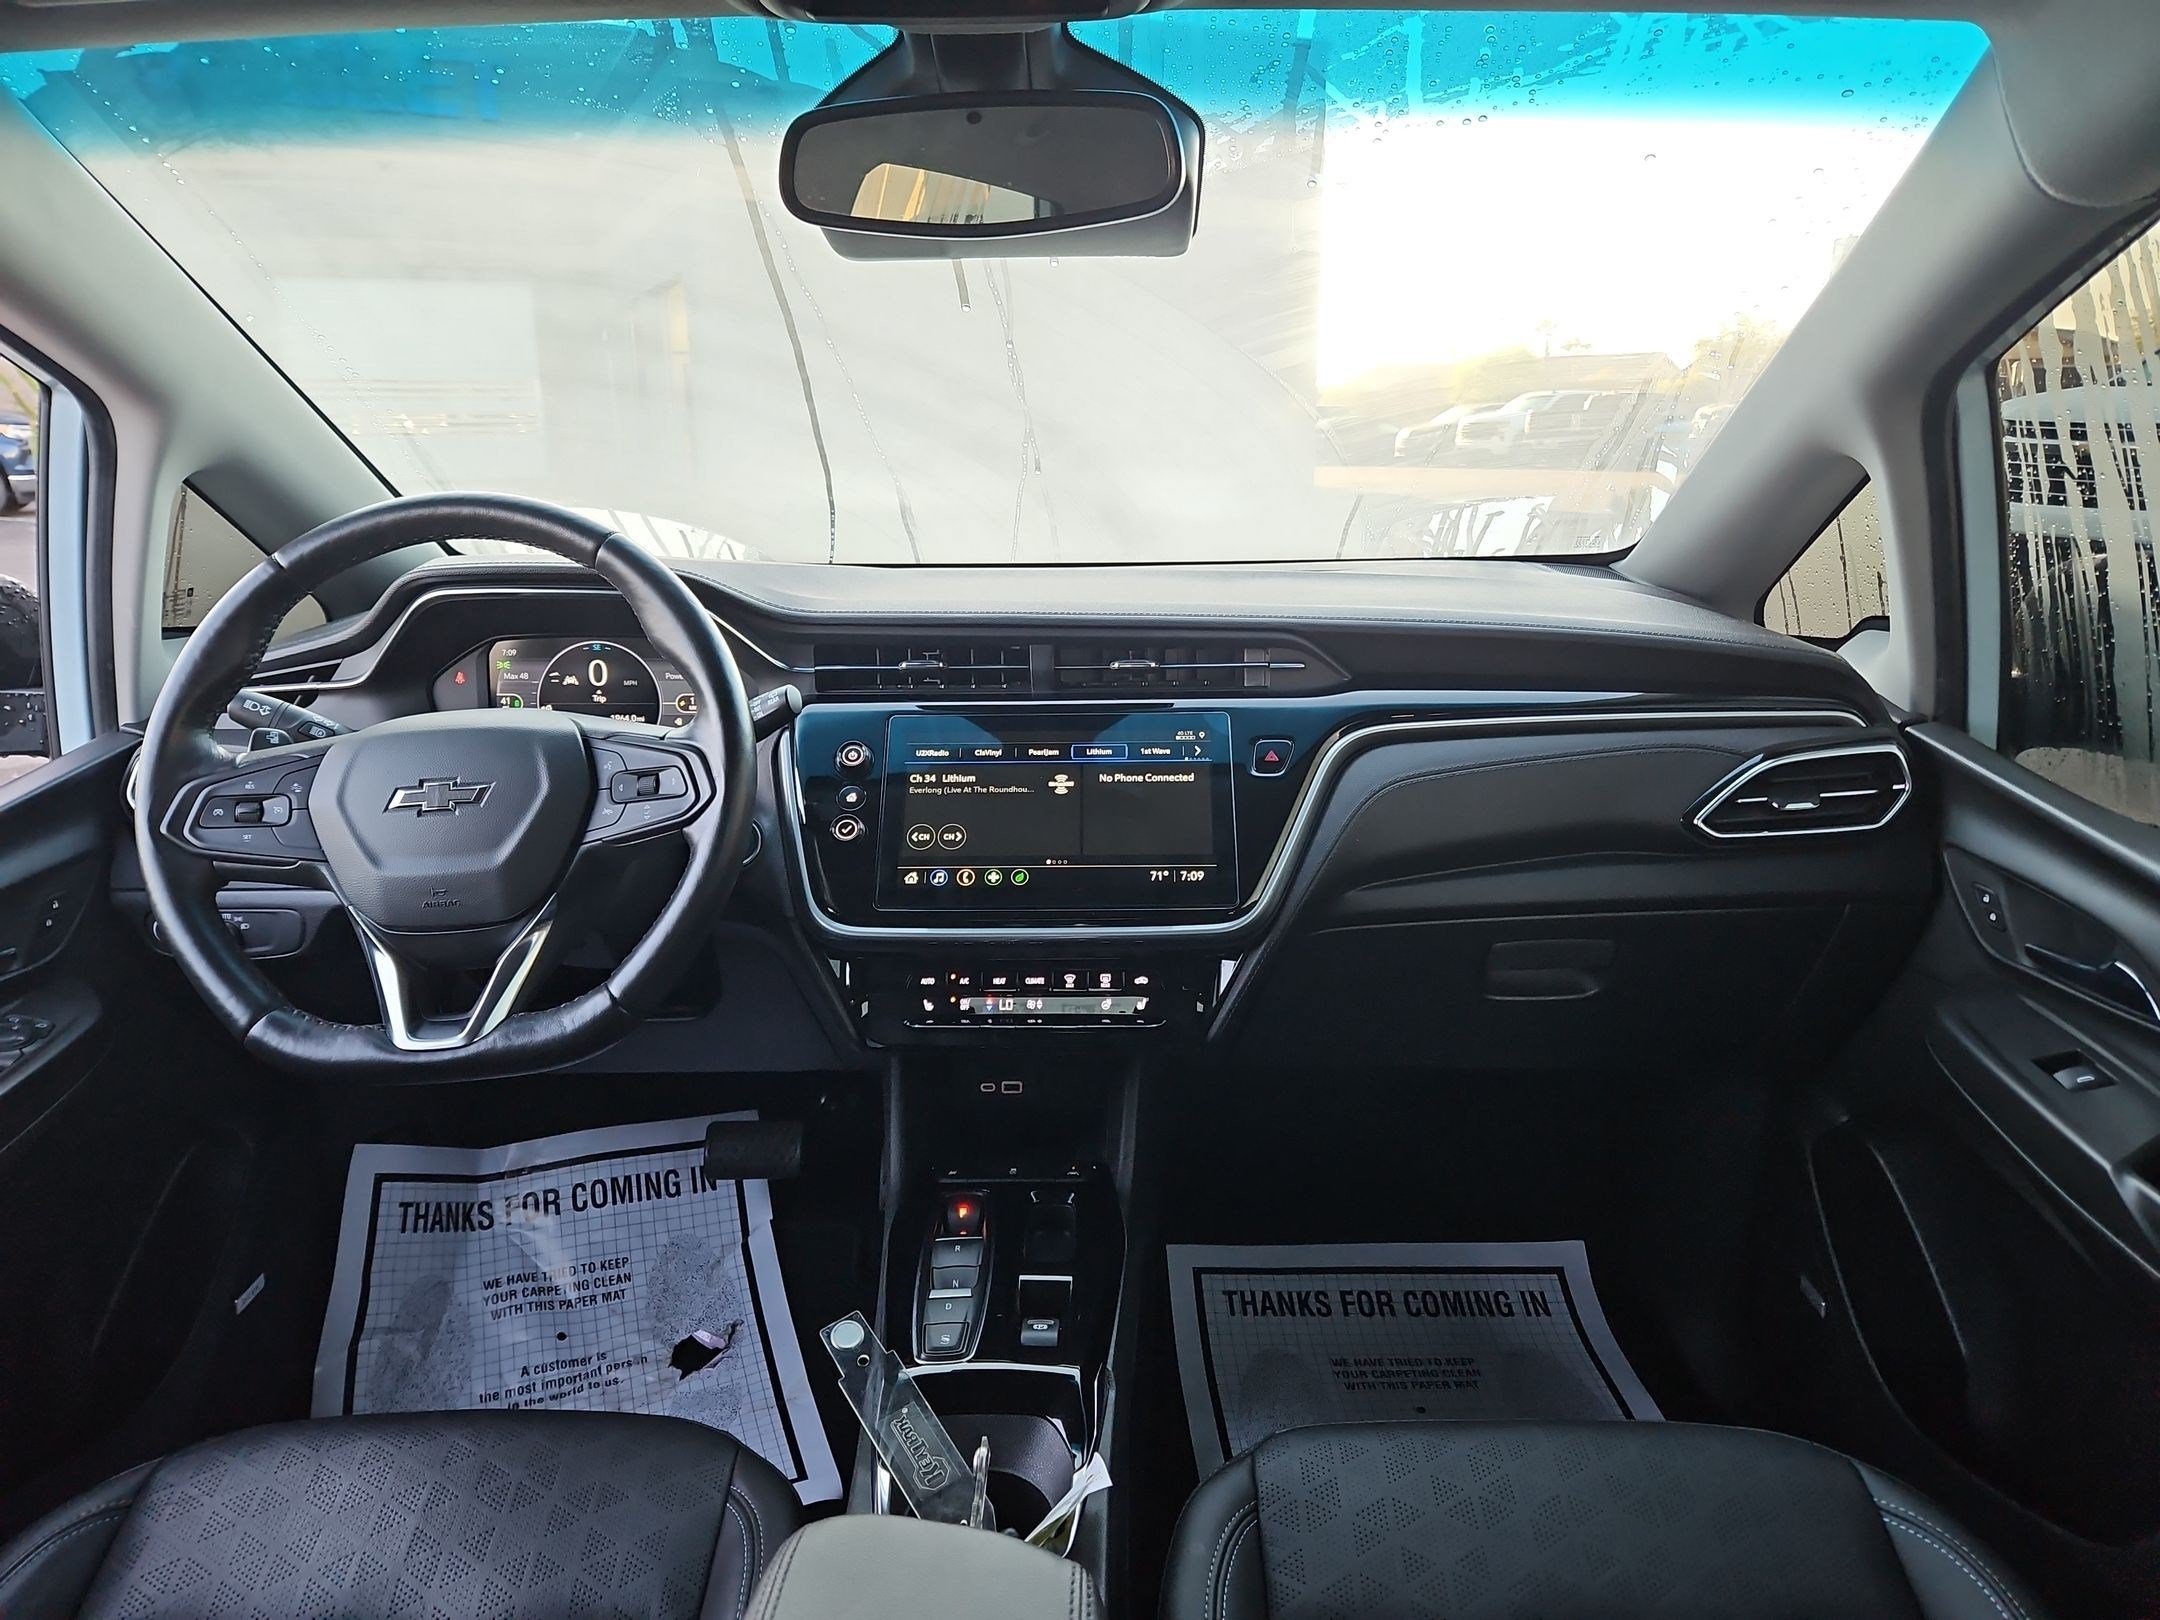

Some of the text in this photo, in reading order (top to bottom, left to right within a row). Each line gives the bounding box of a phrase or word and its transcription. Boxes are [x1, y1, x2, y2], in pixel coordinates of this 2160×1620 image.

[503, 672, 529, 680] Max 48
[588, 659, 608, 687] 0
[500, 697, 511, 705] 41
[592, 694, 607, 704] Trip
[1086, 748, 1112, 756] Lithium
[1140, 747, 1152, 755] 1st
[909, 774, 976, 783] Ch 34 Lithium
[1099, 772, 1195, 783] No Phone Connected
[909, 786, 942, 795] Everlong
[943, 785, 962, 795] (Live
[918, 833, 930, 841] CH
[943, 833, 955, 841] CH
[1150, 870, 1169, 881] 71°
[1180, 870, 1205, 881] 7:09
[920, 977, 936, 985] AUTO
[959, 977, 970, 985] A/C
[398, 1165, 718, 1234] THANKS FOR COMING IN
[483, 1277, 503, 1291] WE
[506, 1271, 538, 1286] HAVE
[580, 1261, 597, 1275] TO
[600, 1256, 630, 1272] KEEP
[952, 1279, 959, 1288] N
[483, 1290, 518, 1307] YOUR
[593, 1272, 632, 1289] CLEAN
[490, 1288, 628, 1321] WITH THIS PAPER MAT
[1222, 1289, 1552, 1318] THANKS FOR COMING IN
[520, 1351, 607, 1378] A customer is
[1330, 1356, 1475, 1368] WE HAVE TRIED TO KEEP
[1332, 1368, 1481, 1380] YOUR CARPETING CLEAN
[479, 1391, 500, 1404] the
[504, 1381, 537, 1399] most
[541, 1365, 602, 1391] important
[1343, 1379, 1480, 1391] WITH THIS PAPER MAT
[524, 1396, 545, 1408] the
[549, 1384, 584, 1401] world
[588, 1380, 600, 1390] to
